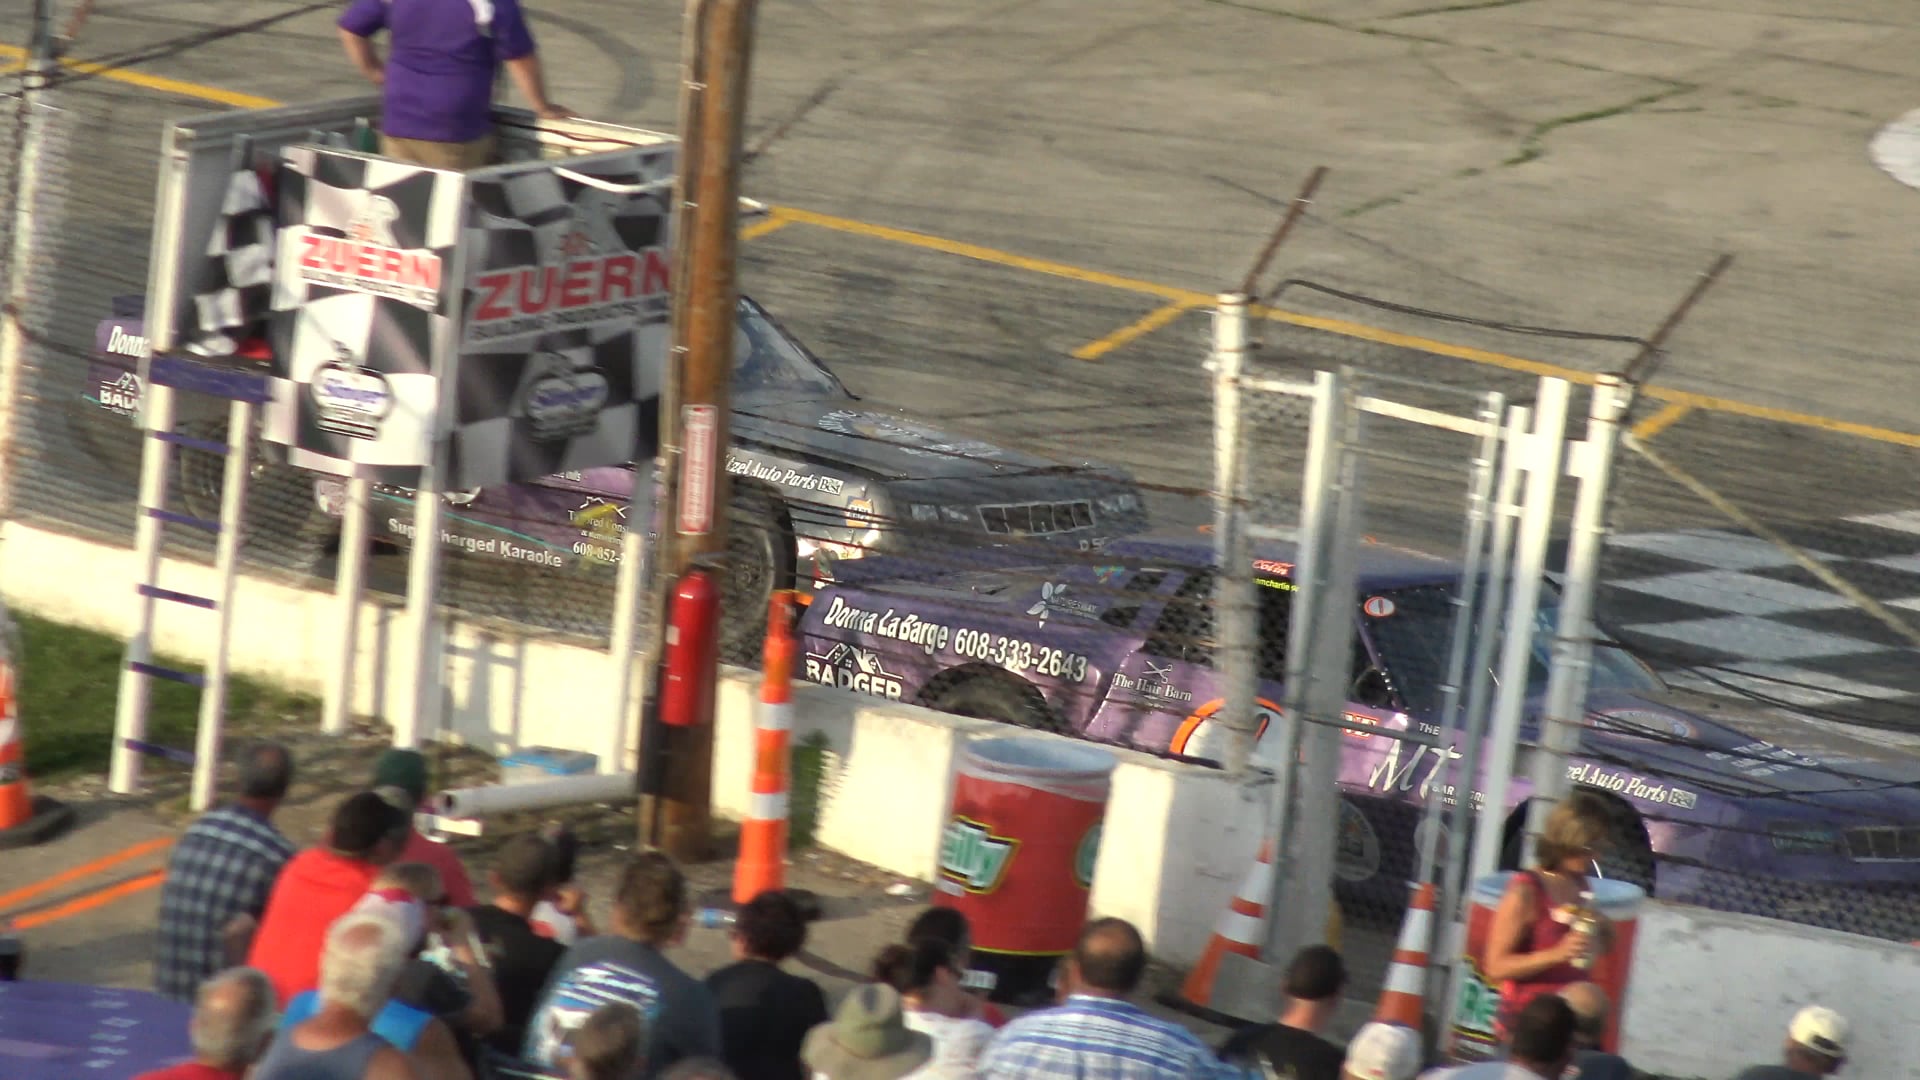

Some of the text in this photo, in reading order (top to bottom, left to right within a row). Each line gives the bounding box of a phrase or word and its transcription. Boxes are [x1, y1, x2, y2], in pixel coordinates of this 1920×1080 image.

[299, 233, 442, 290] ZUERN
[474, 252, 670, 321] ZUERN
[725, 454, 818, 490] tzel Auto Parts
[500, 540, 562, 567] Karaoke
[823, 597, 1087, 682] Donna LaBarge 608-333-2643
[1112, 673, 1192, 702] The Hair Barn
[1419, 722, 1441, 736] THE
[1586, 768, 1624, 790] Auto
[1623, 777, 1668, 803] Parts
